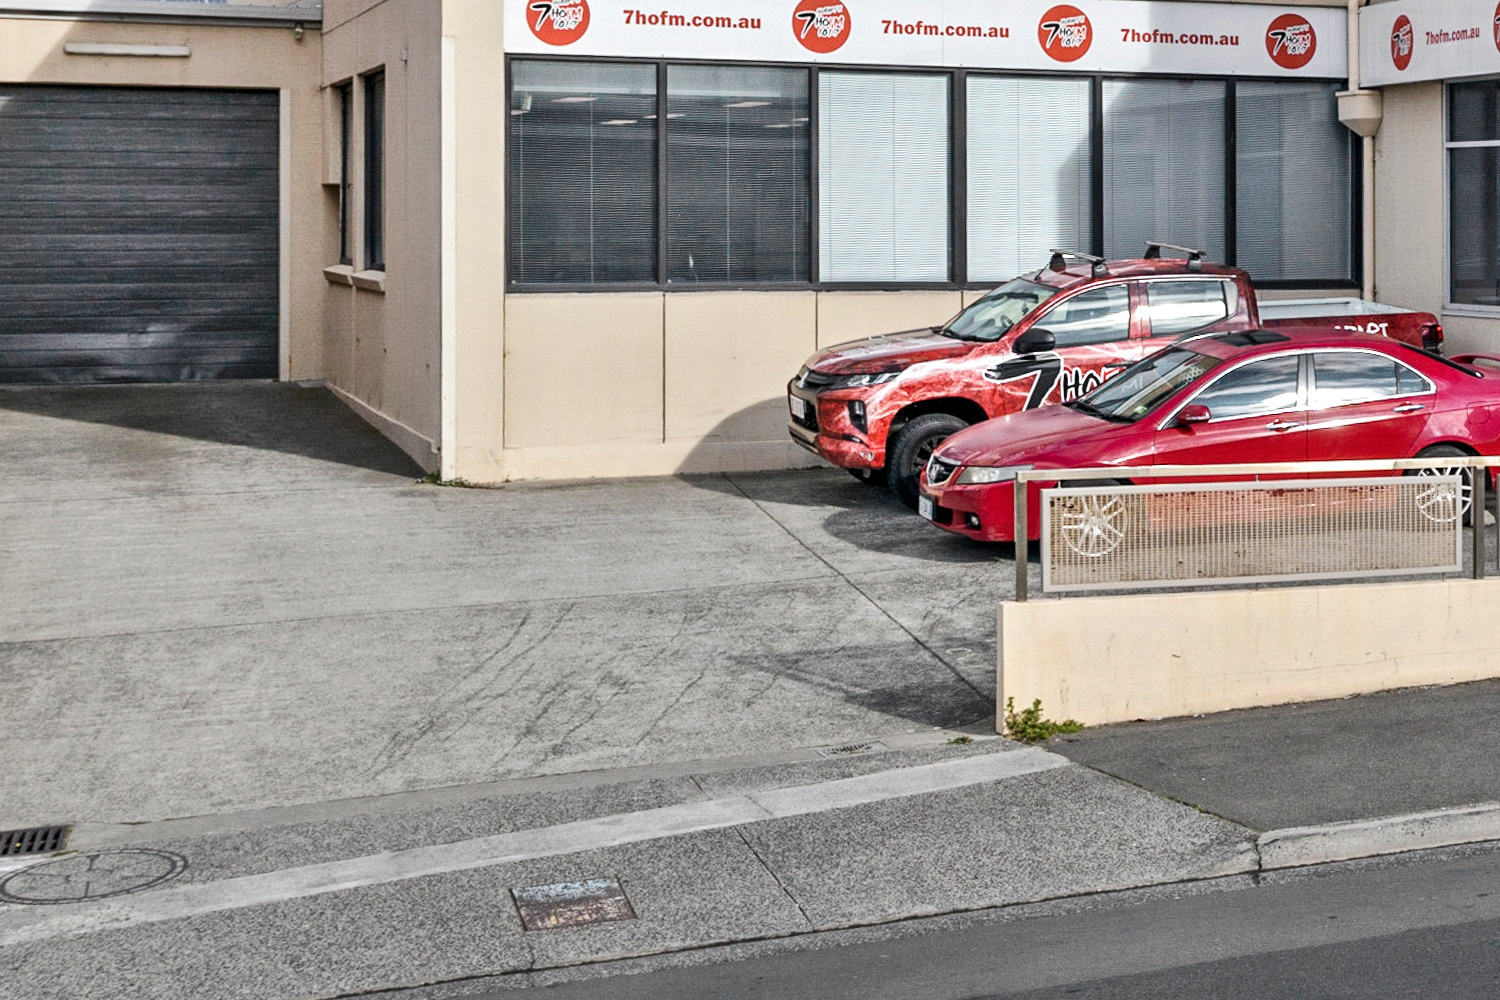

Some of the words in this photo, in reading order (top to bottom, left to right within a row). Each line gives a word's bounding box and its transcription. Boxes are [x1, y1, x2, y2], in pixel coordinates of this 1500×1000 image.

[624, 10, 761, 29] 7hofm.com.au
[882, 20, 1009, 38] 7hofm.com.au
[1121, 29, 1238, 45] 7hofm.com.au
[1426, 27, 1480, 44] 7hofm.com.au
